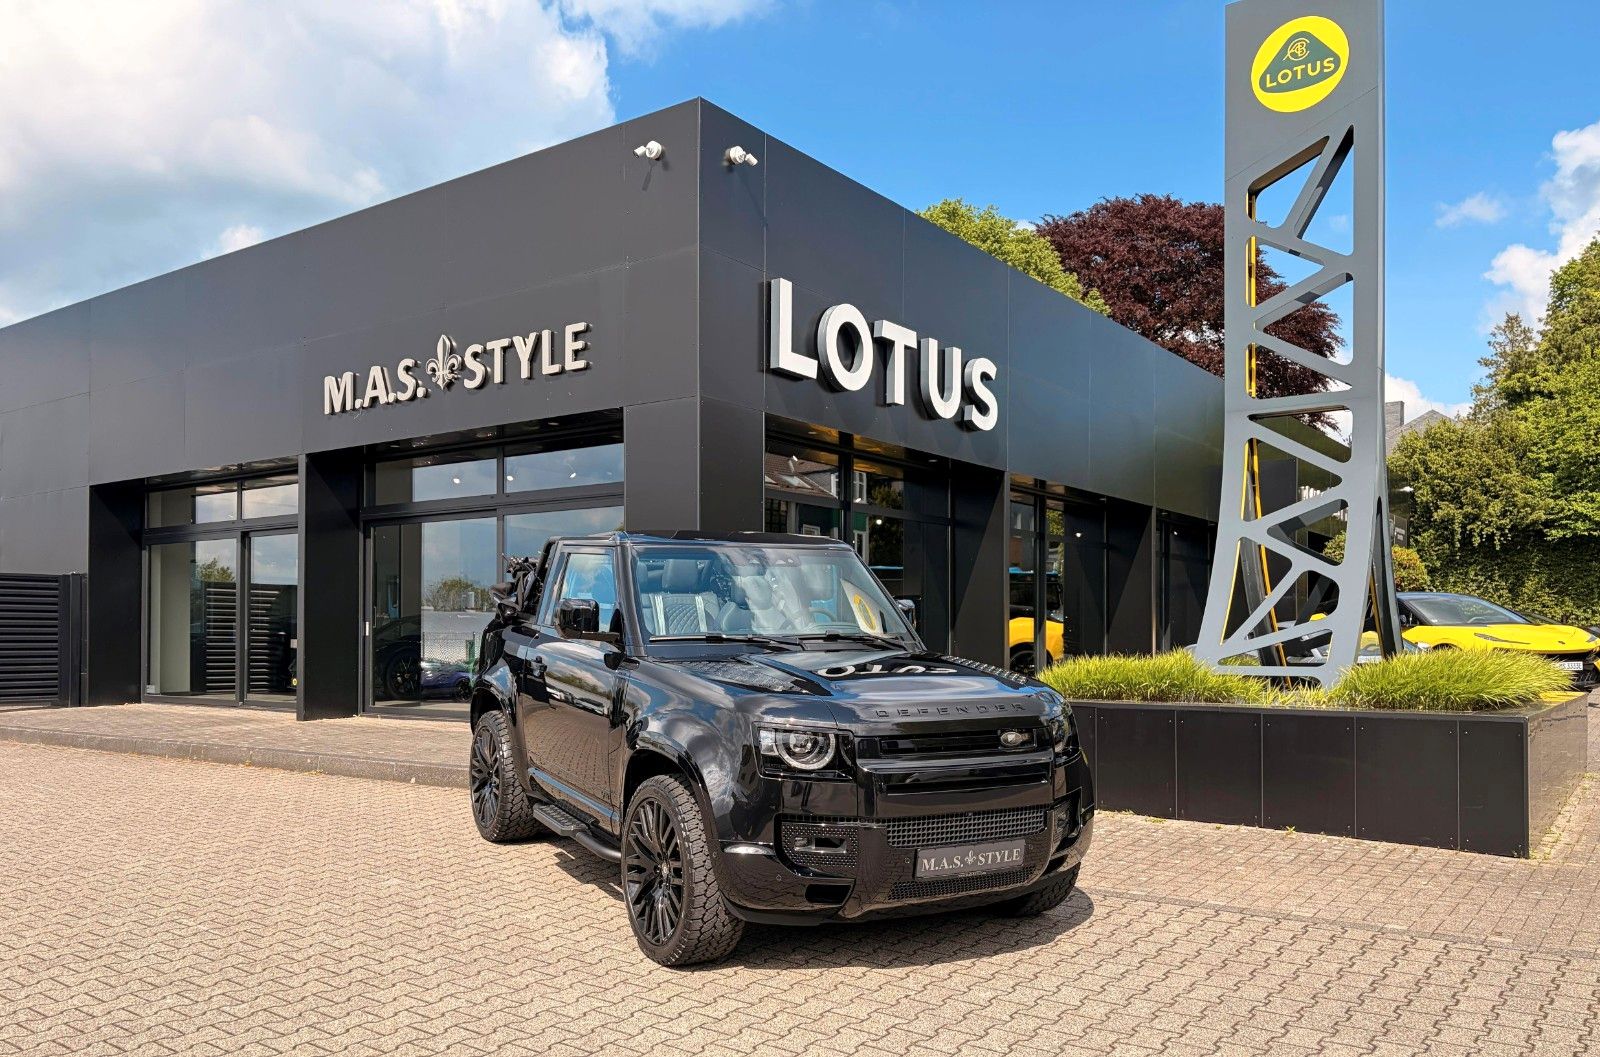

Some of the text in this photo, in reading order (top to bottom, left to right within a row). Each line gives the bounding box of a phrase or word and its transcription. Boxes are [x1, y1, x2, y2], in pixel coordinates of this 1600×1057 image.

[1265, 57, 1335, 88] LOTUS
[324, 321, 588, 415] M.A.S. STYLE
[770, 277, 998, 431] LOTUS
[875, 703, 1027, 718] DEFENDER
[921, 848, 1021, 872] M.A.S. STYLE
